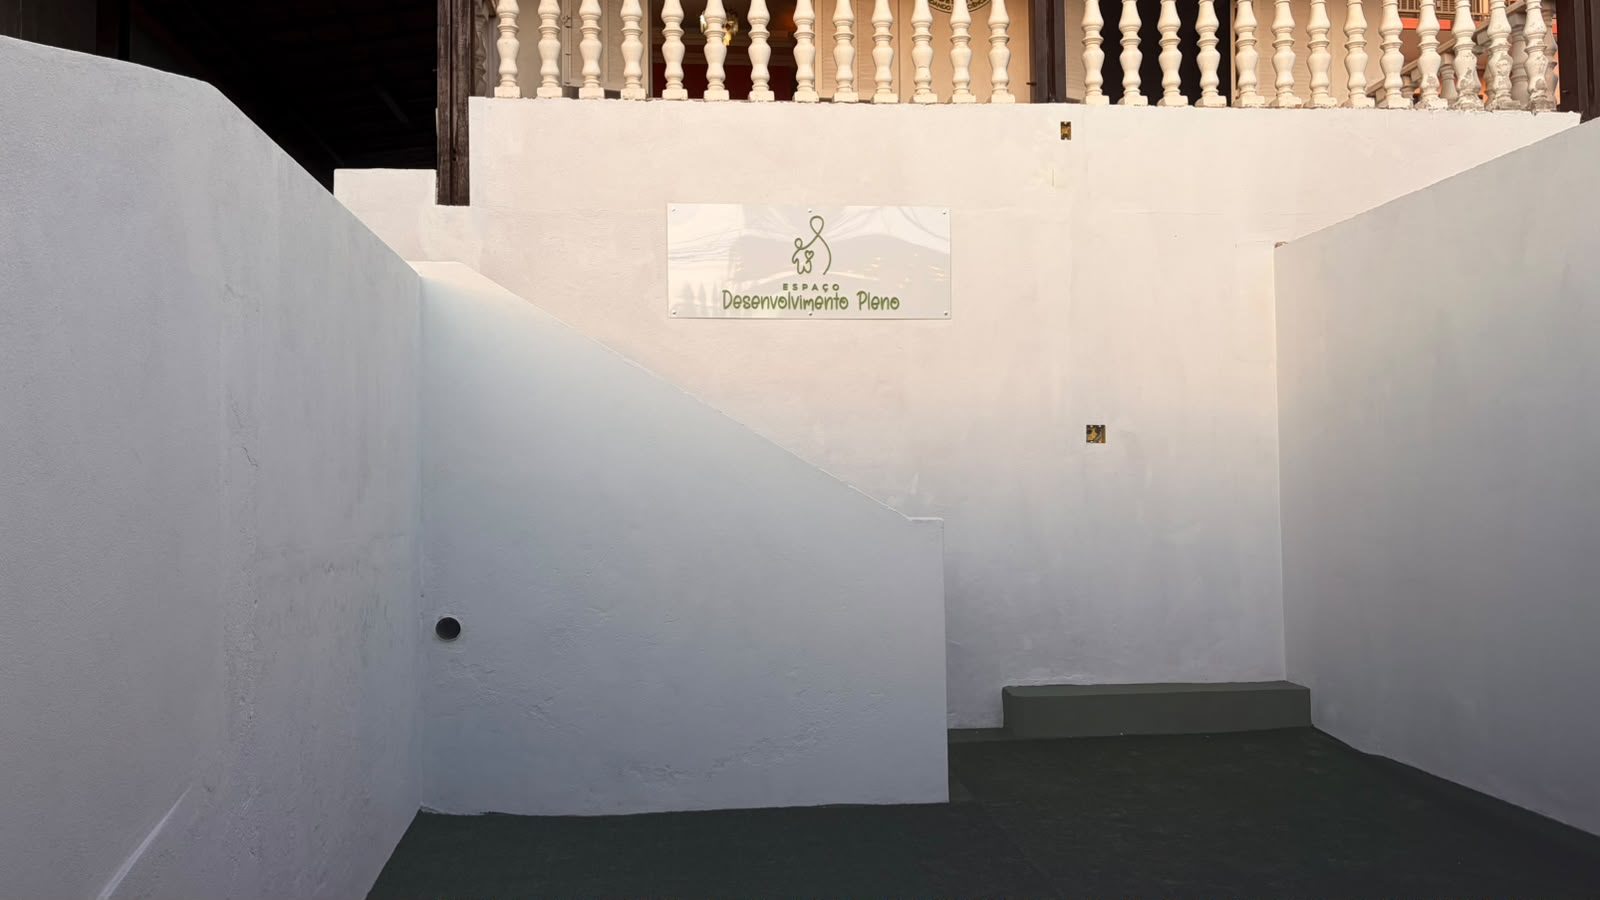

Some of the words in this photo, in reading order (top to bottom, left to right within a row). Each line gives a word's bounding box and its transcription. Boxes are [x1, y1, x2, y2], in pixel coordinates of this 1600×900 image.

[782, 283, 840, 292] ESPAÇO
[722, 289, 849, 310] Desenvolvimento
[856, 290, 900, 311] Pleno
